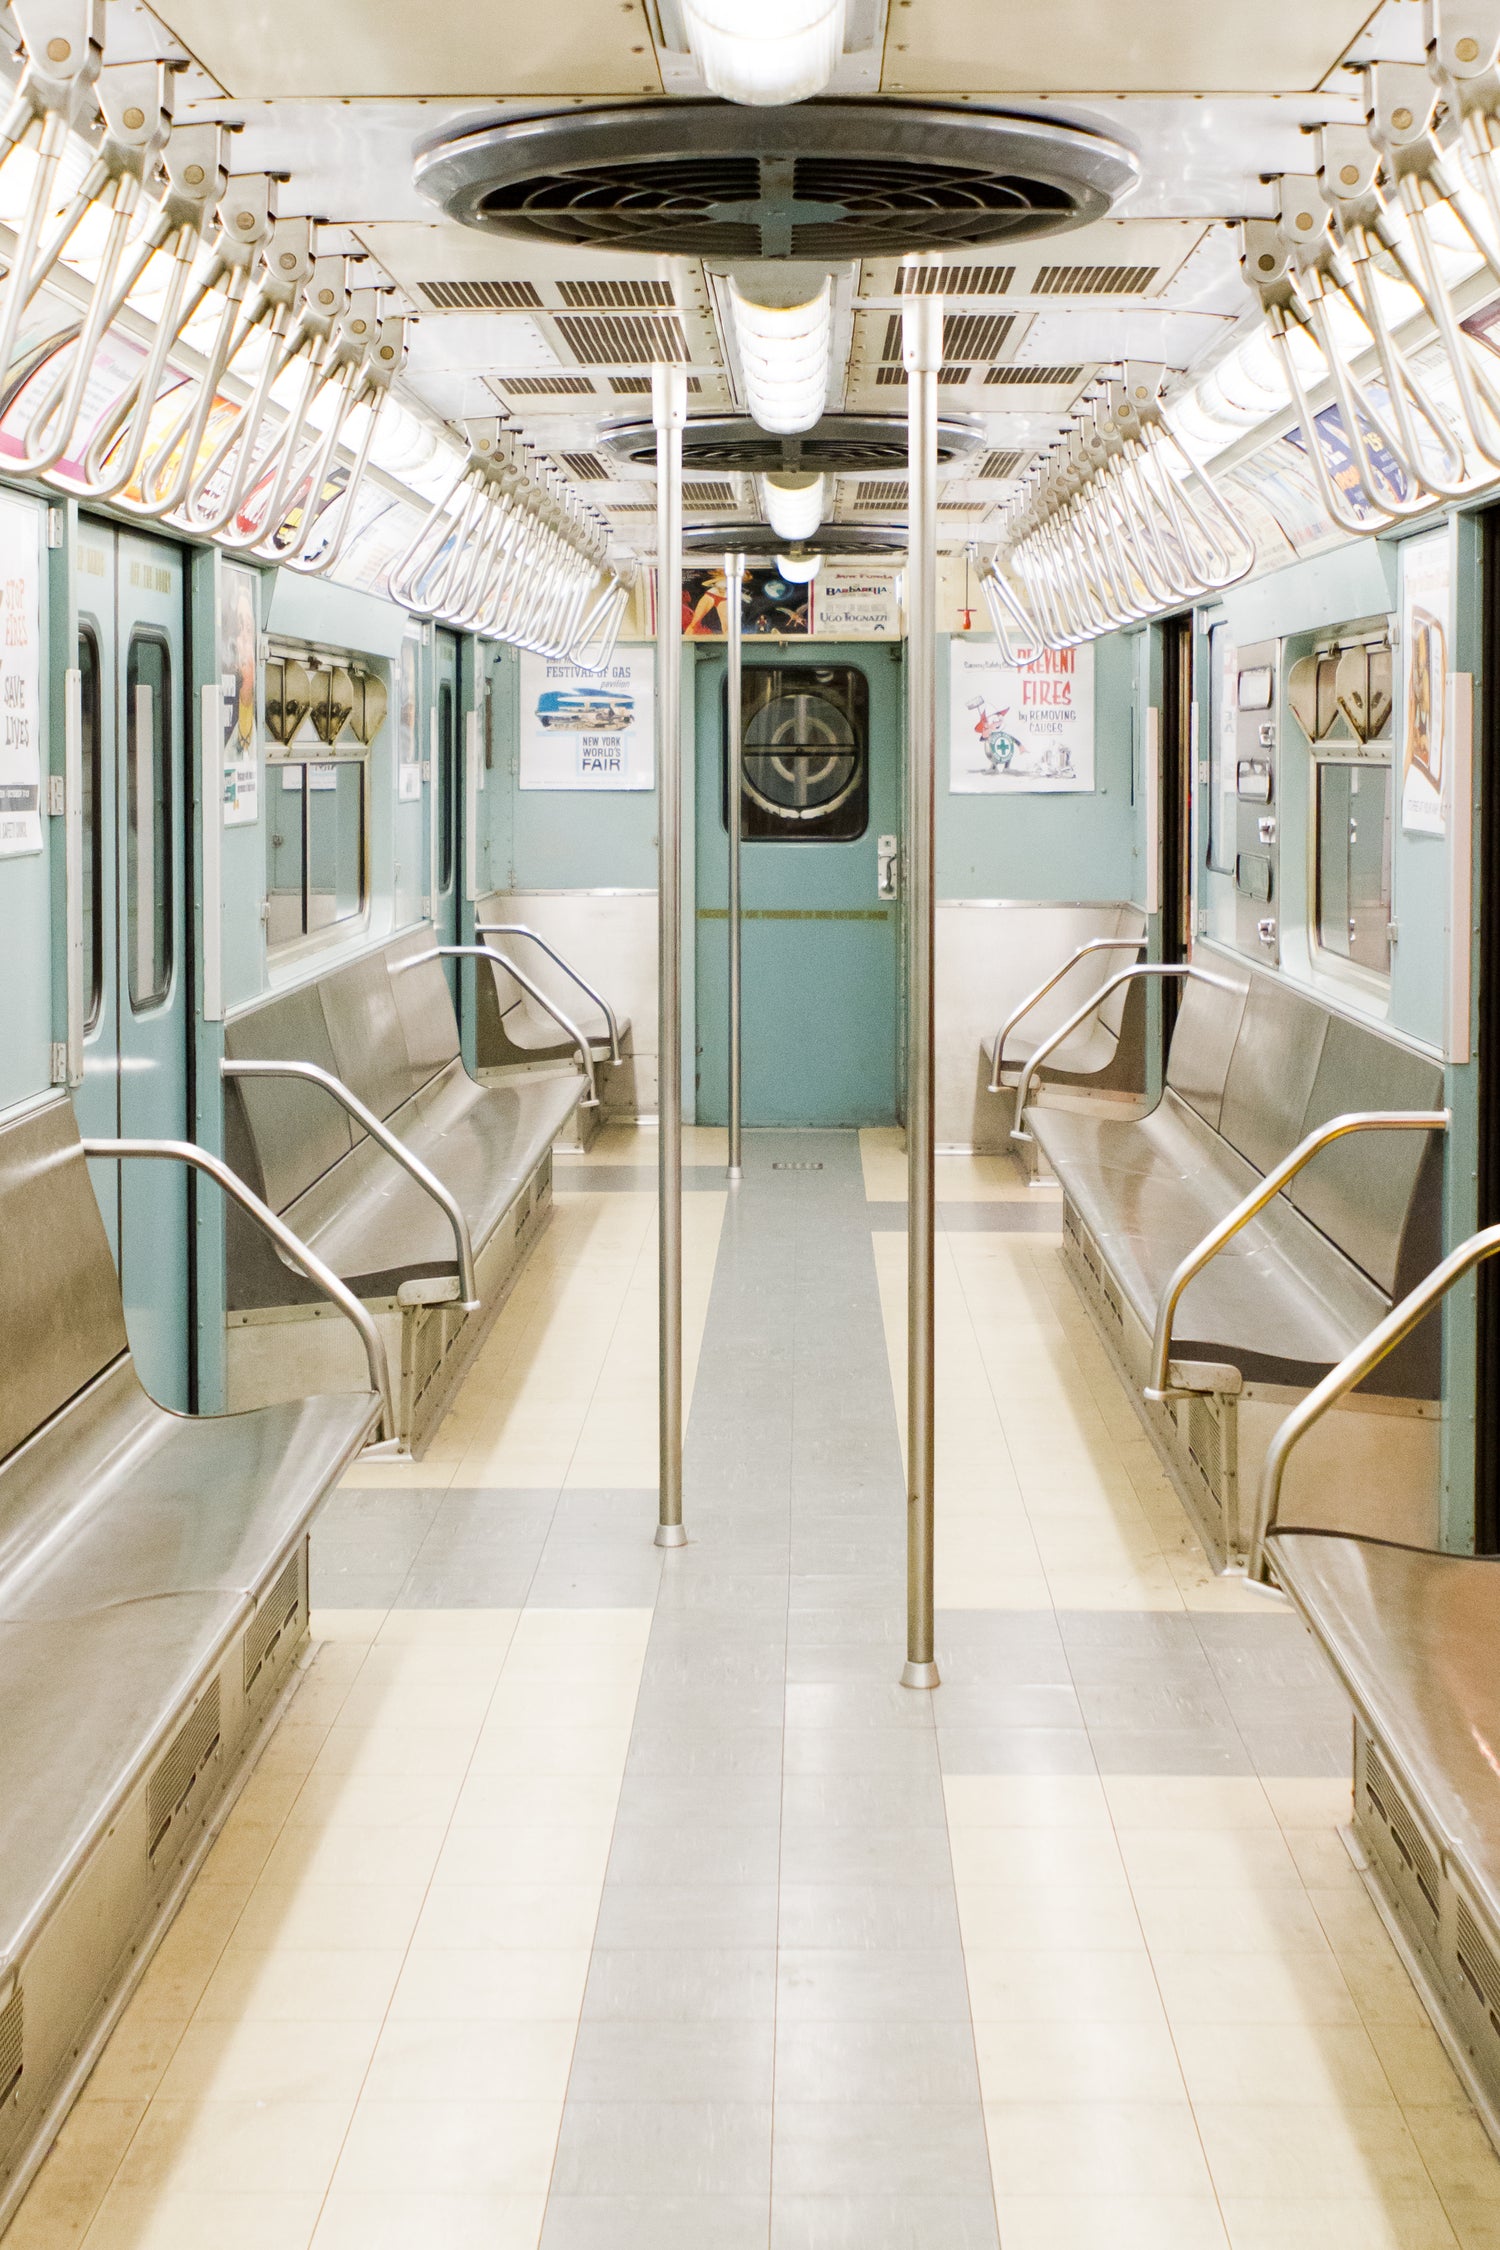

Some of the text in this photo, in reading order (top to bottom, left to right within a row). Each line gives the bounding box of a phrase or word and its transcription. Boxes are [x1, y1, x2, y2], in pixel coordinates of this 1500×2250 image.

[546, 666, 594, 678] FESTIVAL
[612, 667, 631, 678] GAS
[5, 675, 25, 709] SAVE
[1023, 680, 1072, 706] FIRES
[1018, 710, 1077, 722] by REMOVING
[1029, 722, 1063, 733] CAUSES
[582, 736, 621, 746] NEW YORK
[582, 747, 621, 757] WORLD'S
[582, 758, 621, 771] FAIR
